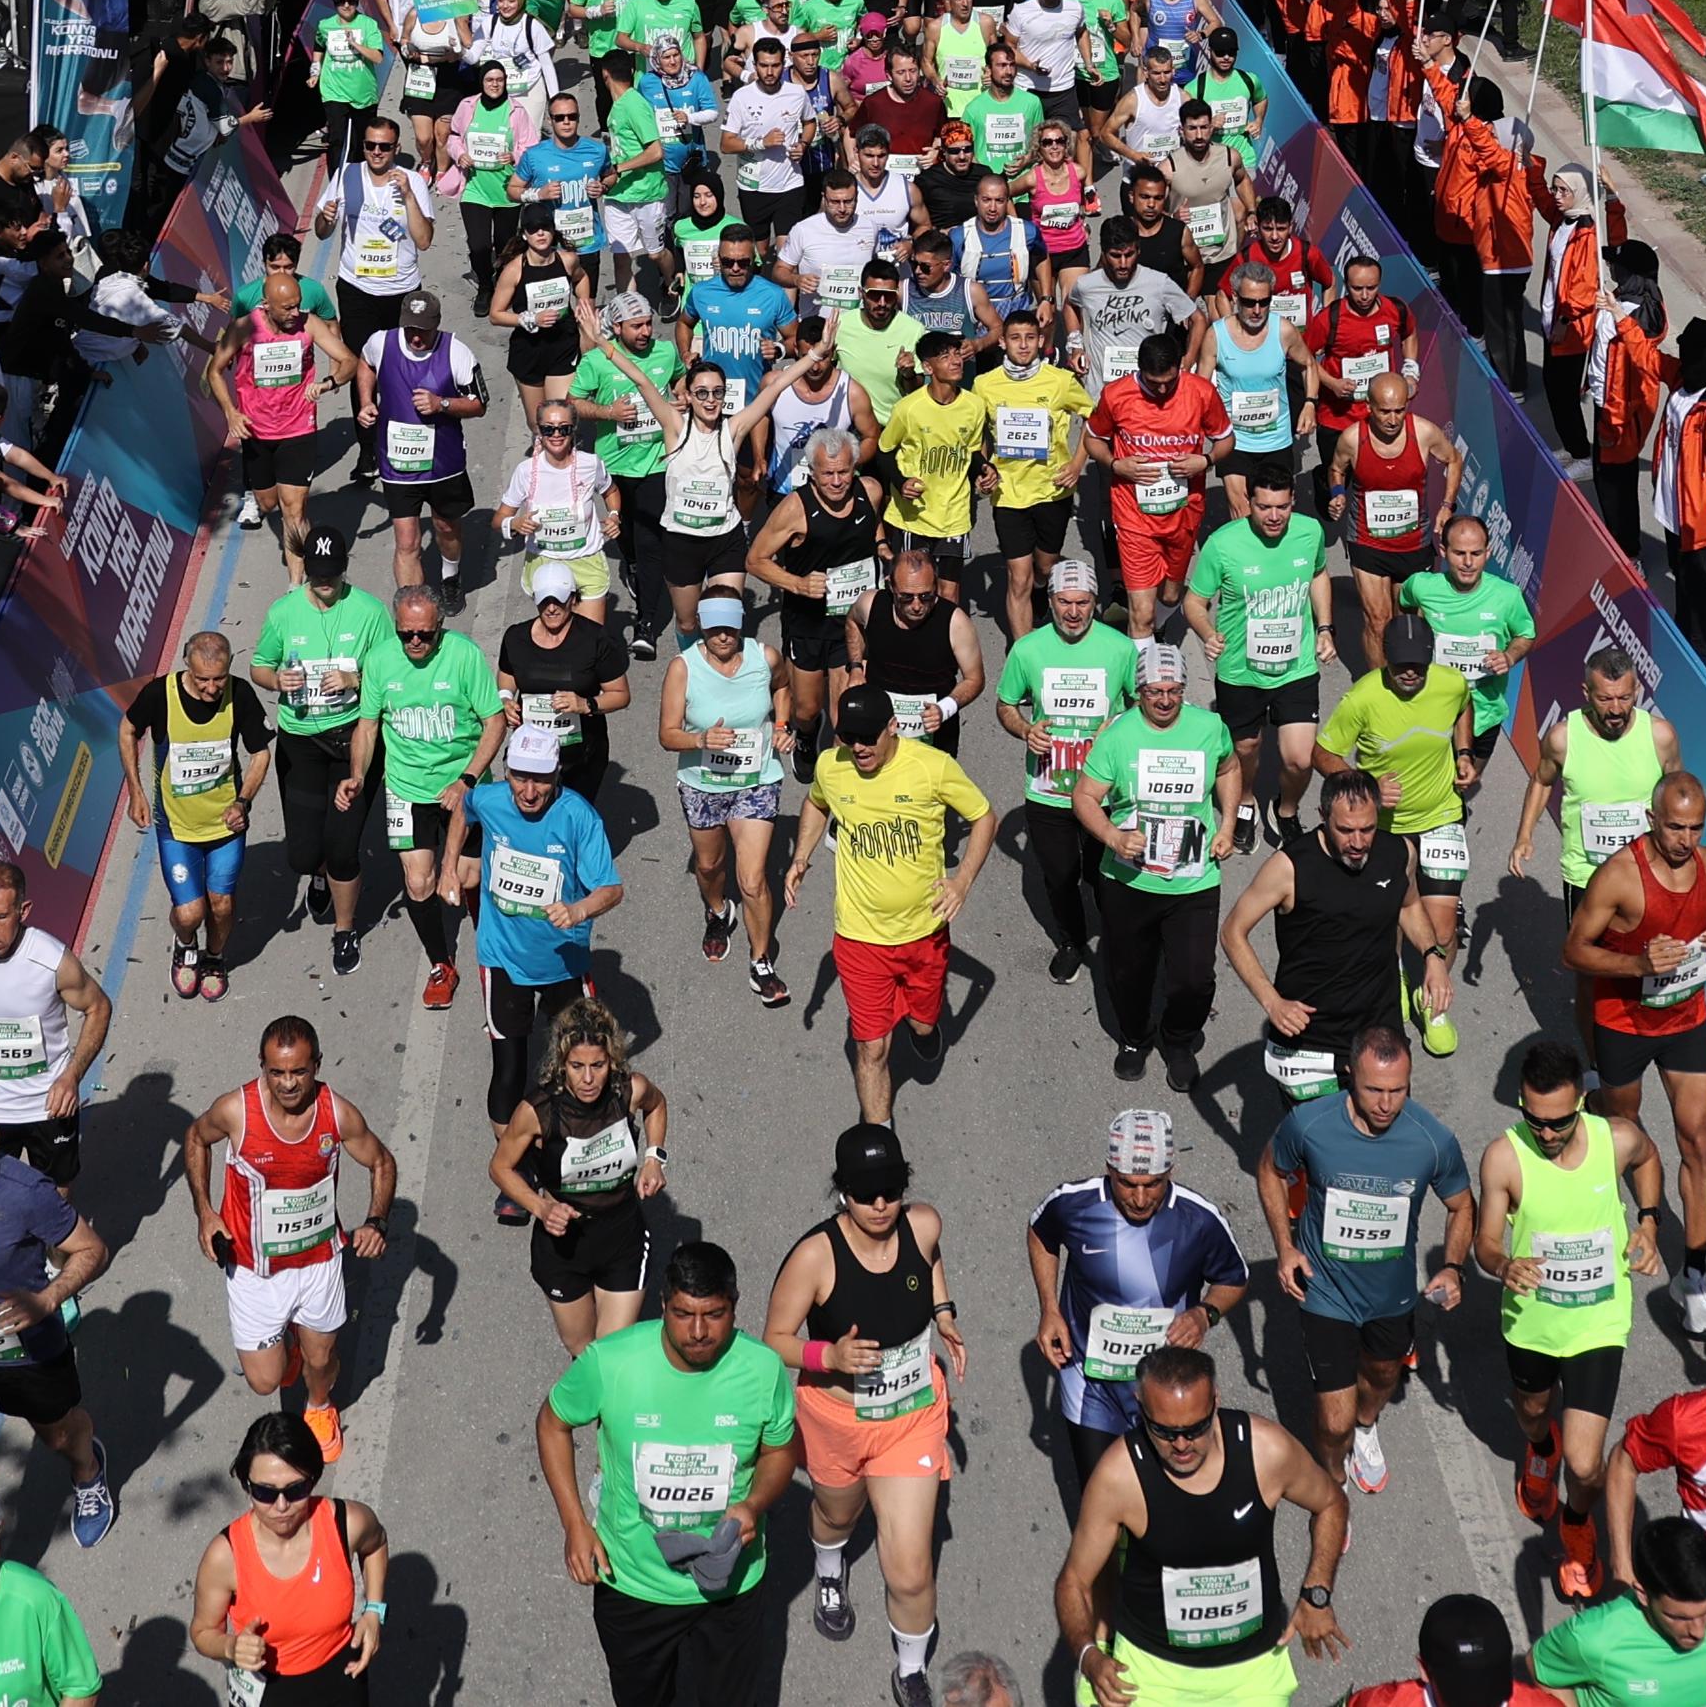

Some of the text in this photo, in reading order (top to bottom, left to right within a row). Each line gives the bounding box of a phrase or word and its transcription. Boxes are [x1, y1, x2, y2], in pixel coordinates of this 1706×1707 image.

[51, 24, 97, 36] KONYA
[68, 34, 96, 46] YARI
[45, 44, 119, 59] MARATONU
[1104, 294, 1144, 312] KEEP
[1095, 309, 1150, 331] STARING
[1007, 431, 1038, 441] 2625
[1144, 486, 1180, 498] 12369
[683, 498, 718, 511] 10467
[1374, 511, 1411, 522] 10032
[76, 473, 123, 586] KONYA
[107, 508, 145, 593] YARI
[113, 507, 176, 679] MARATONU
[1590, 577, 1663, 692] ULUSLARARASI
[1256, 644, 1293, 655] 10818
[1053, 698, 1095, 709] 10976
[30, 697, 52, 739] SPOR
[36, 707, 66, 767] KONYA
[710, 753, 753, 766] 10465
[1148, 782, 1193, 794] 10690
[498, 877, 544, 898] 10939
[577, 1159, 623, 1179] 11574
[285, 1192, 317, 1205] KONYA
[1350, 1199, 1386, 1210] KONYA
[274, 1197, 327, 1215] MARATONU
[1336, 1207, 1397, 1221] MARATONU
[276, 1213, 323, 1234] 11536
[1339, 1226, 1391, 1240] 11559
[1555, 1239, 1592, 1250] KONYA
[1562, 1245, 1586, 1254] YARI
[1544, 1247, 1604, 1260] MARATONU
[1546, 1265, 1604, 1283] 10532
[1115, 1312, 1152, 1323] KONYA
[1101, 1319, 1162, 1334] MARATONU
[868, 1367, 921, 1397] 10435
[666, 1452, 705, 1464] KONYA
[671, 1459, 699, 1470] YARI
[652, 1463, 718, 1476] MARATONU
[649, 1485, 714, 1501] 10026
[1192, 1574, 1234, 1586] KONYA
[1177, 1581, 1249, 1597] MARATONU
[1199, 1582, 1226, 1592] YARI
[1180, 1599, 1248, 1620] 10865
